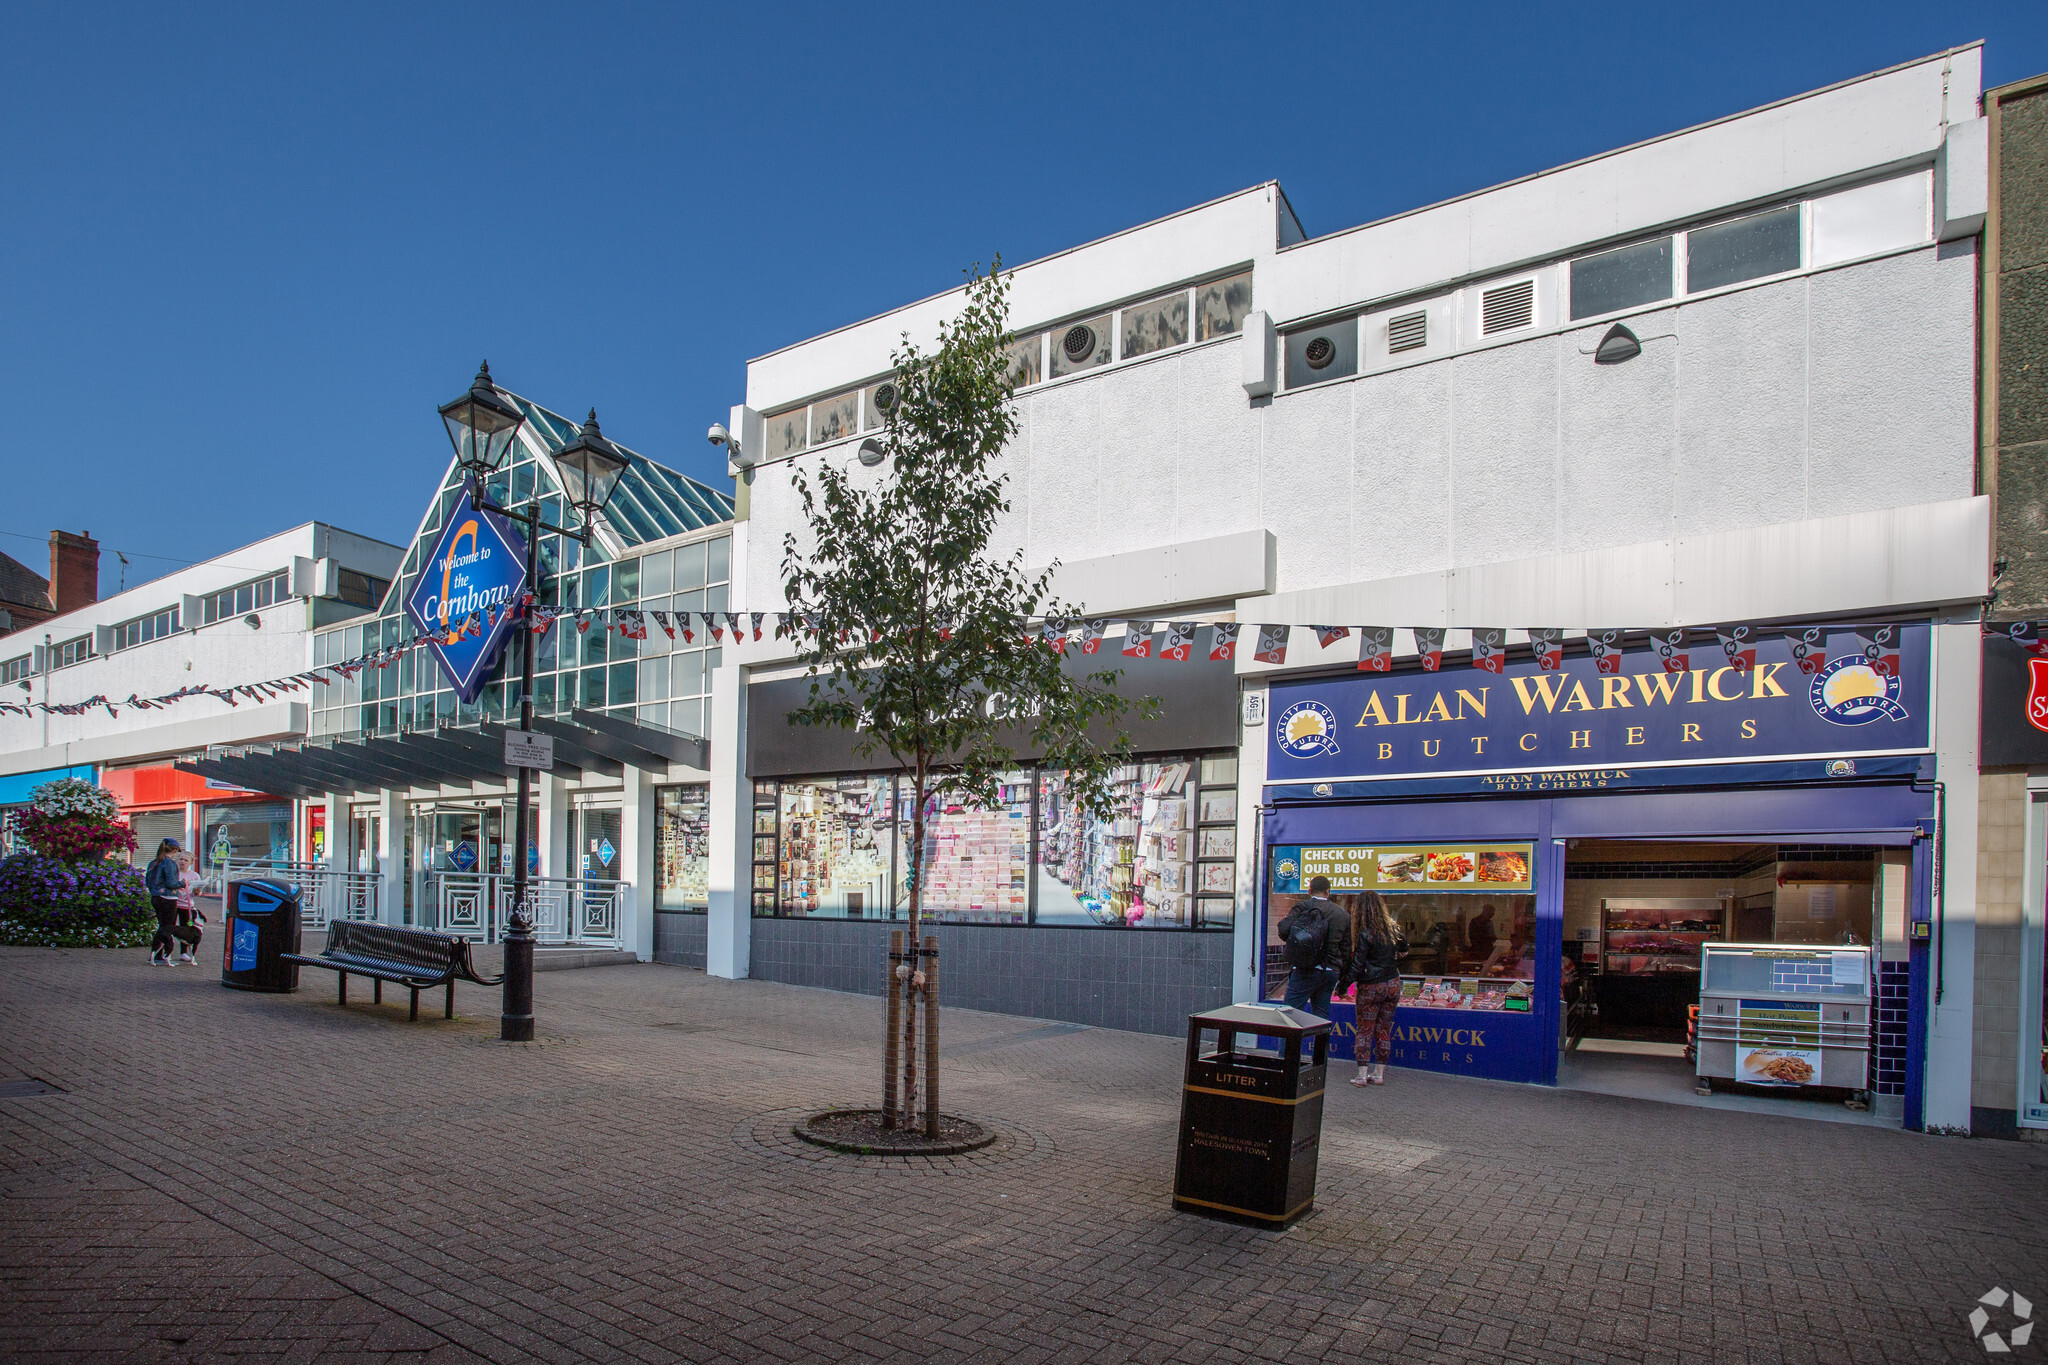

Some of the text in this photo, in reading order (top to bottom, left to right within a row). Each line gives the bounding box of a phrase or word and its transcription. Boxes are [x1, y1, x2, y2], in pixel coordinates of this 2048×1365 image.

[439, 547, 491, 572] Welcome to
[454, 573, 469, 589] the
[423, 584, 509, 622] Cornbow
[1355, 662, 1789, 727] ALAN WARWICK
[1812, 660, 1843, 714] QUALITY
[1834, 697, 1899, 715] FUTURE
[1278, 706, 1299, 749] QUALITY
[1321, 709, 1334, 730] OUR
[1292, 735, 1334, 750] FUTURE
[1377, 719, 1757, 760] BUTCHERS
[1481, 770, 1630, 784] ALAN WARWICK
[1496, 780, 1607, 790] BUTCHERS
[1304, 849, 1374, 860] CHECK OUT
[1304, 863, 1331, 874] OUR
[1334, 863, 1360, 875] BBQ
[1783, 1002, 1818, 1010] WARWICK
[1390, 1022, 1486, 1047] ARWICK
[1752, 1021, 1807, 1031] Sandwiches
[1216, 1072, 1256, 1086] LITTER
[1194, 1137, 1268, 1157] HALESOWEN TOWN
